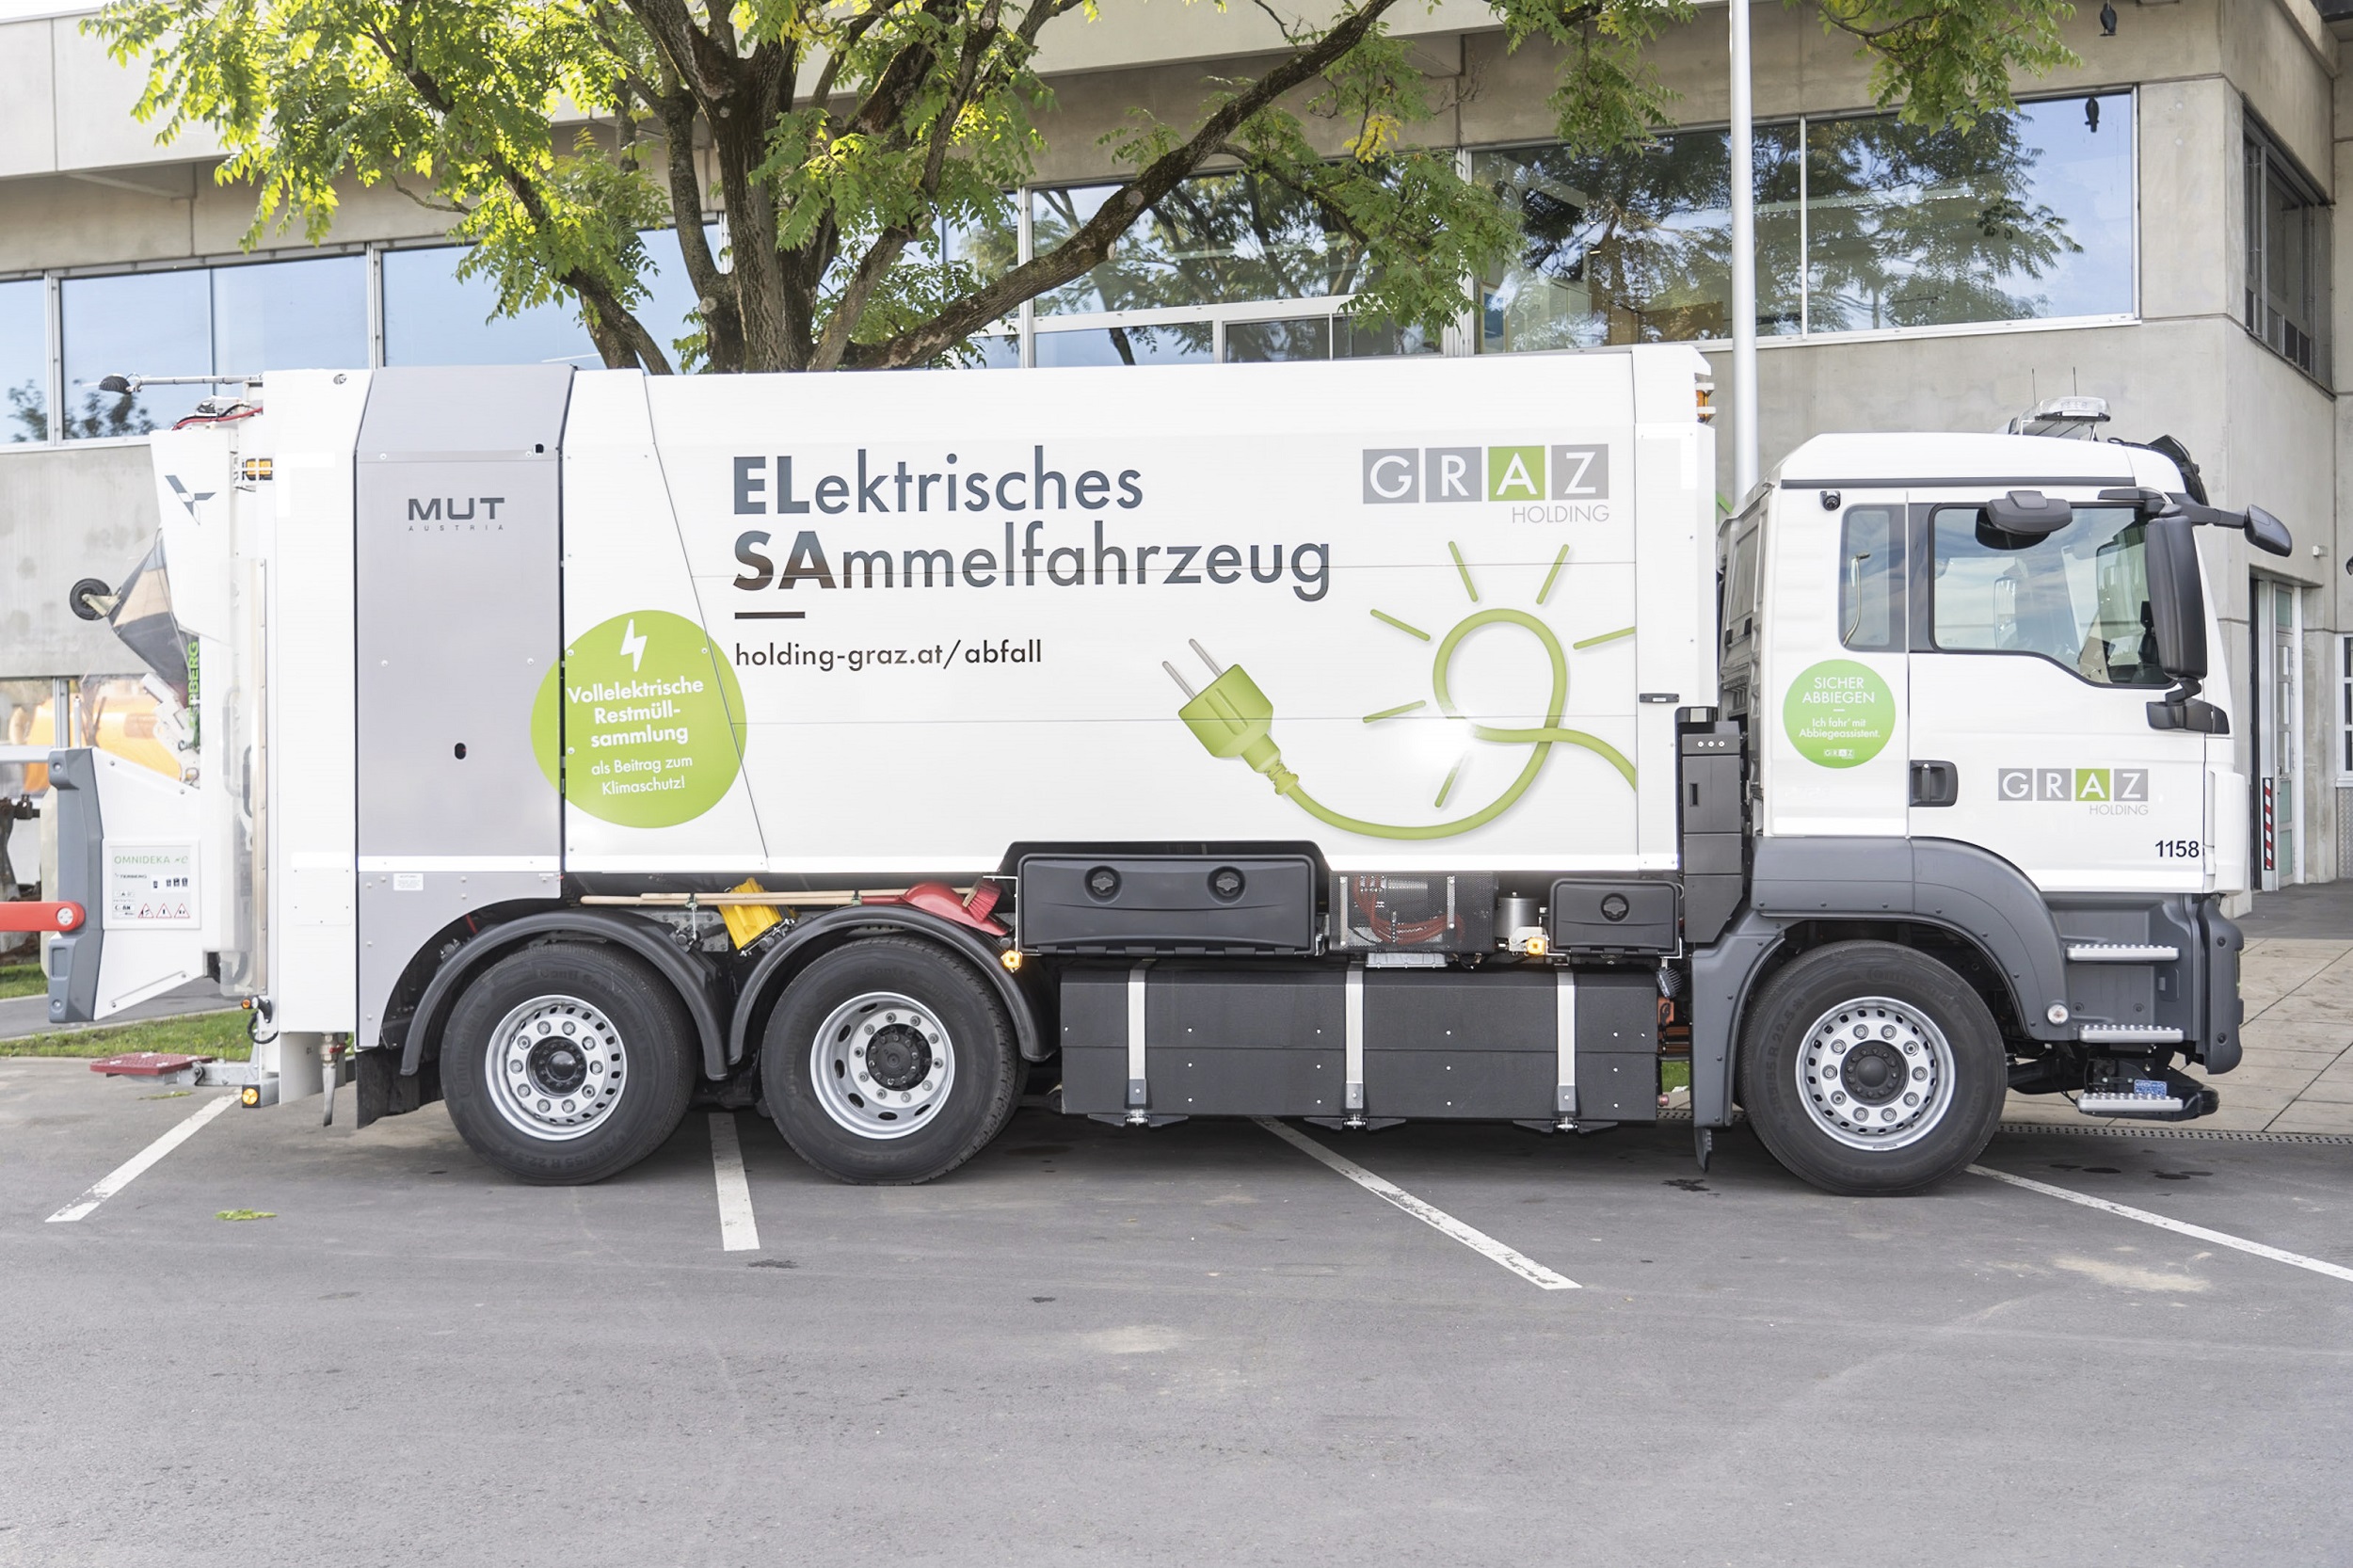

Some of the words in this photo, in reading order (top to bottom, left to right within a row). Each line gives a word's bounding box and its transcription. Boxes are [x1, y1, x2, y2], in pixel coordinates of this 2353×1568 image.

[734, 445, 1143, 514] ELektrisches
[1367, 448, 1602, 501] GRAZ
[408, 497, 505, 520] MUT
[1512, 504, 1609, 523] HOLDING
[733, 520, 1330, 601] SAmmelfahrzeug
[735, 639, 1042, 670] holding-graz.at/abfall
[567, 676, 704, 704] Vollelektrische
[1814, 677, 1864, 689] SICHER
[1801, 692, 1875, 704] ABBIEGEN
[594, 699, 680, 725] Restmüll-
[1812, 717, 1826, 728] Ich
[1852, 718, 1866, 728] mit
[591, 724, 688, 747] sammlung
[1799, 728, 1880, 741] Abbiegeassistent.
[591, 760, 610, 776] als
[614, 759, 662, 774] Beitrag
[665, 757, 693, 769] zum
[602, 776, 685, 795] Klimaschutz!
[2001, 770, 2144, 799] GRAZ
[2089, 804, 2149, 816] HOLDING
[2154, 840, 2200, 858] 1158
[114, 856, 170, 865] OMNIDEKA
